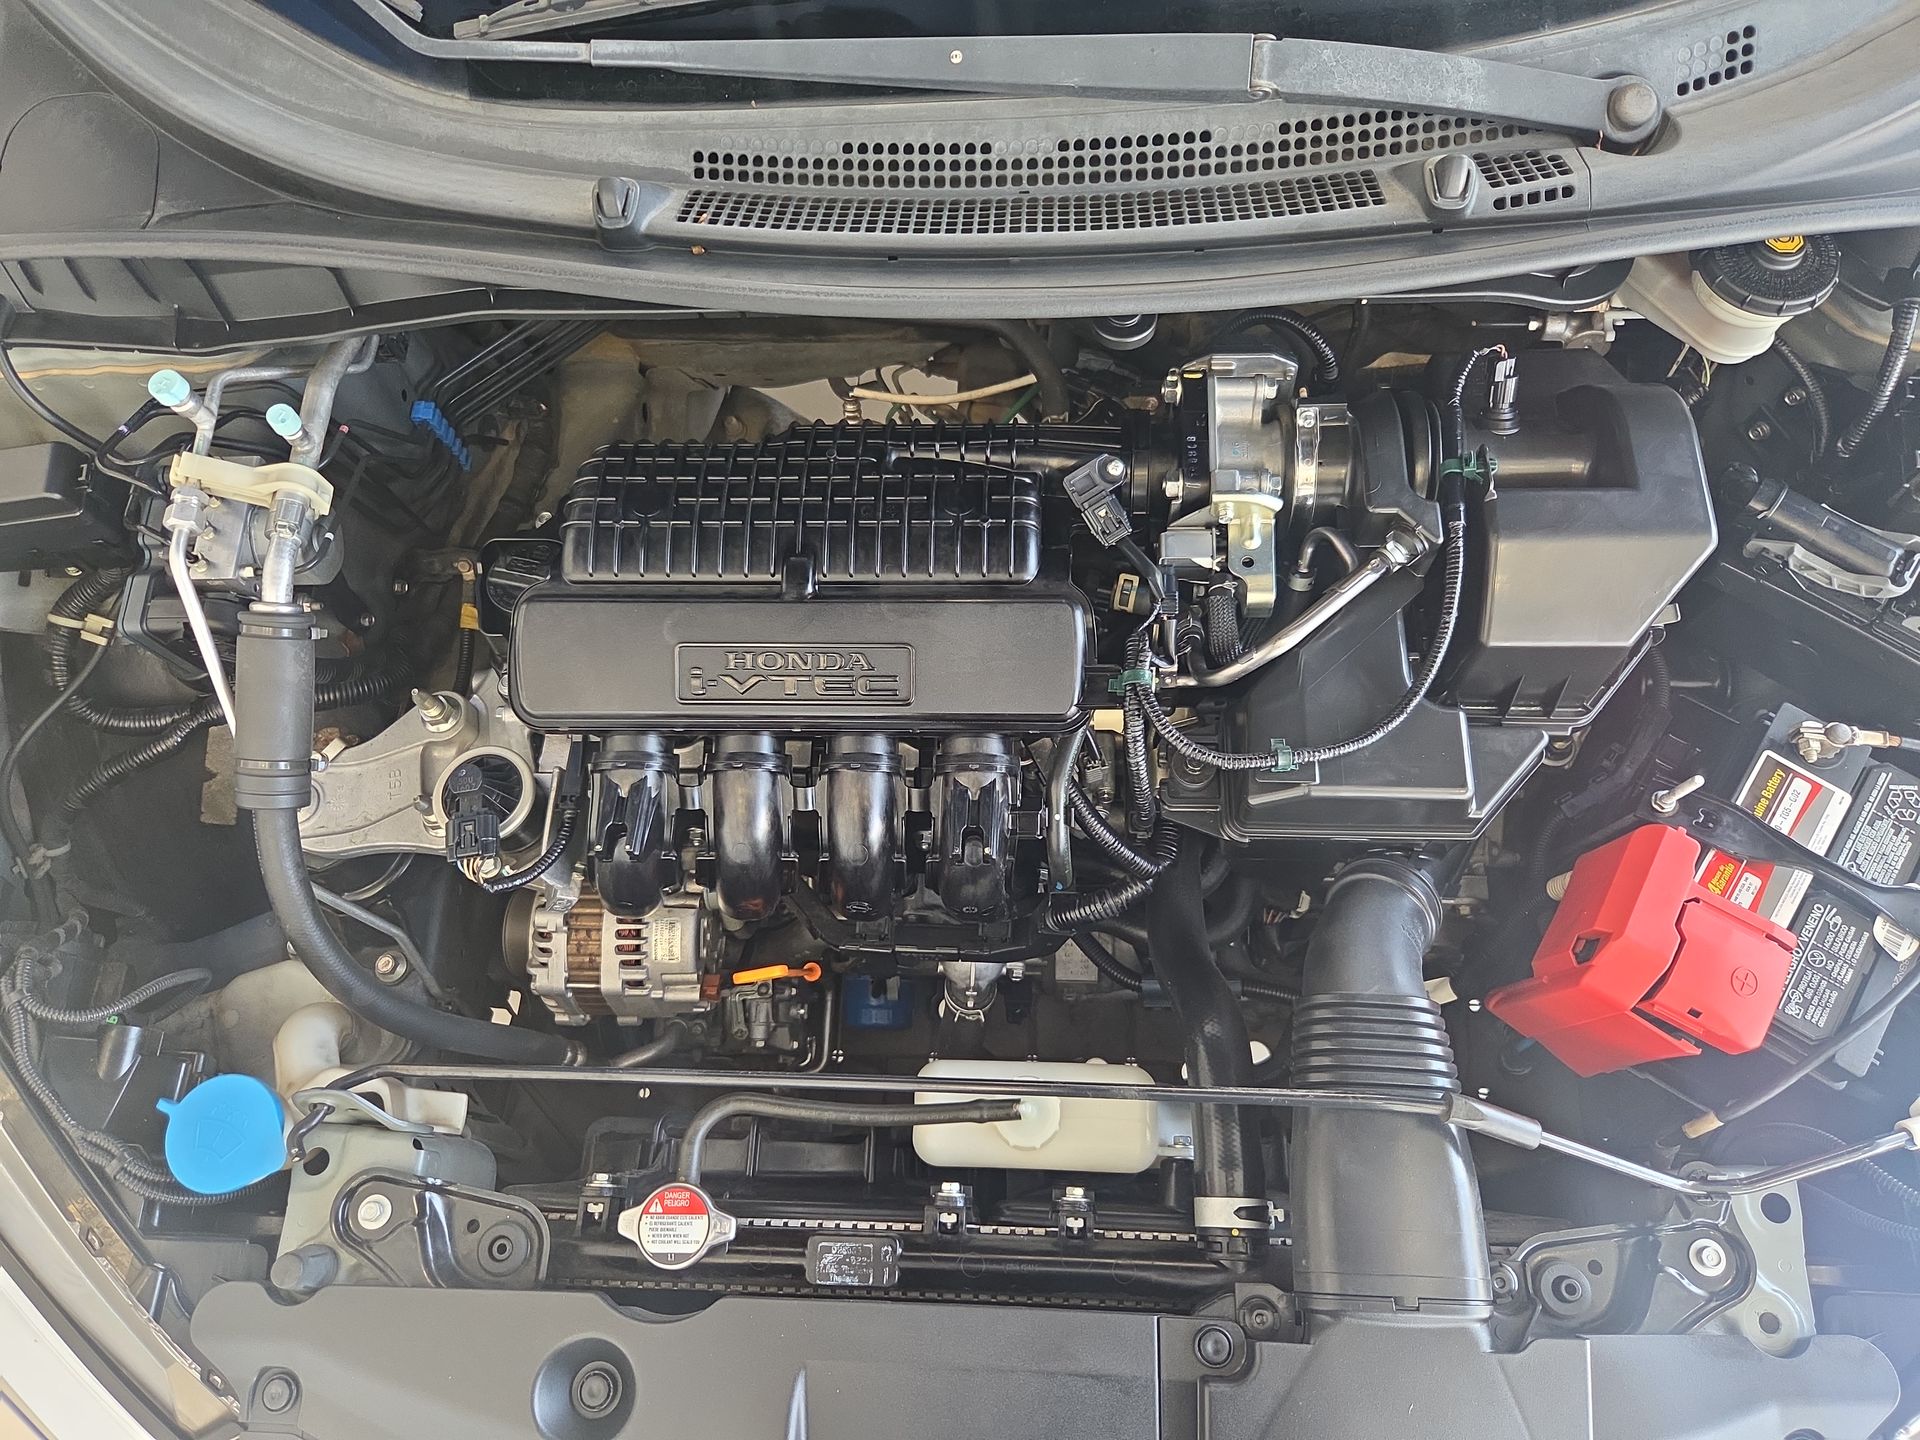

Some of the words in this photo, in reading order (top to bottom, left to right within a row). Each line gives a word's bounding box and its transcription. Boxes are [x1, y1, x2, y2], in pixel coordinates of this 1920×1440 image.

[725, 652, 876, 671] HONDA
[690, 667, 899, 696] i-VTEC
[1753, 797, 1769, 818] uine
[1761, 768, 1786, 799] Battery
[1826, 960, 1834, 970] NO
[1798, 969, 1812, 992] PROTEJA
[664, 1191, 690, 1199] DANGER
[664, 1199, 690, 1207] PELIGRO
